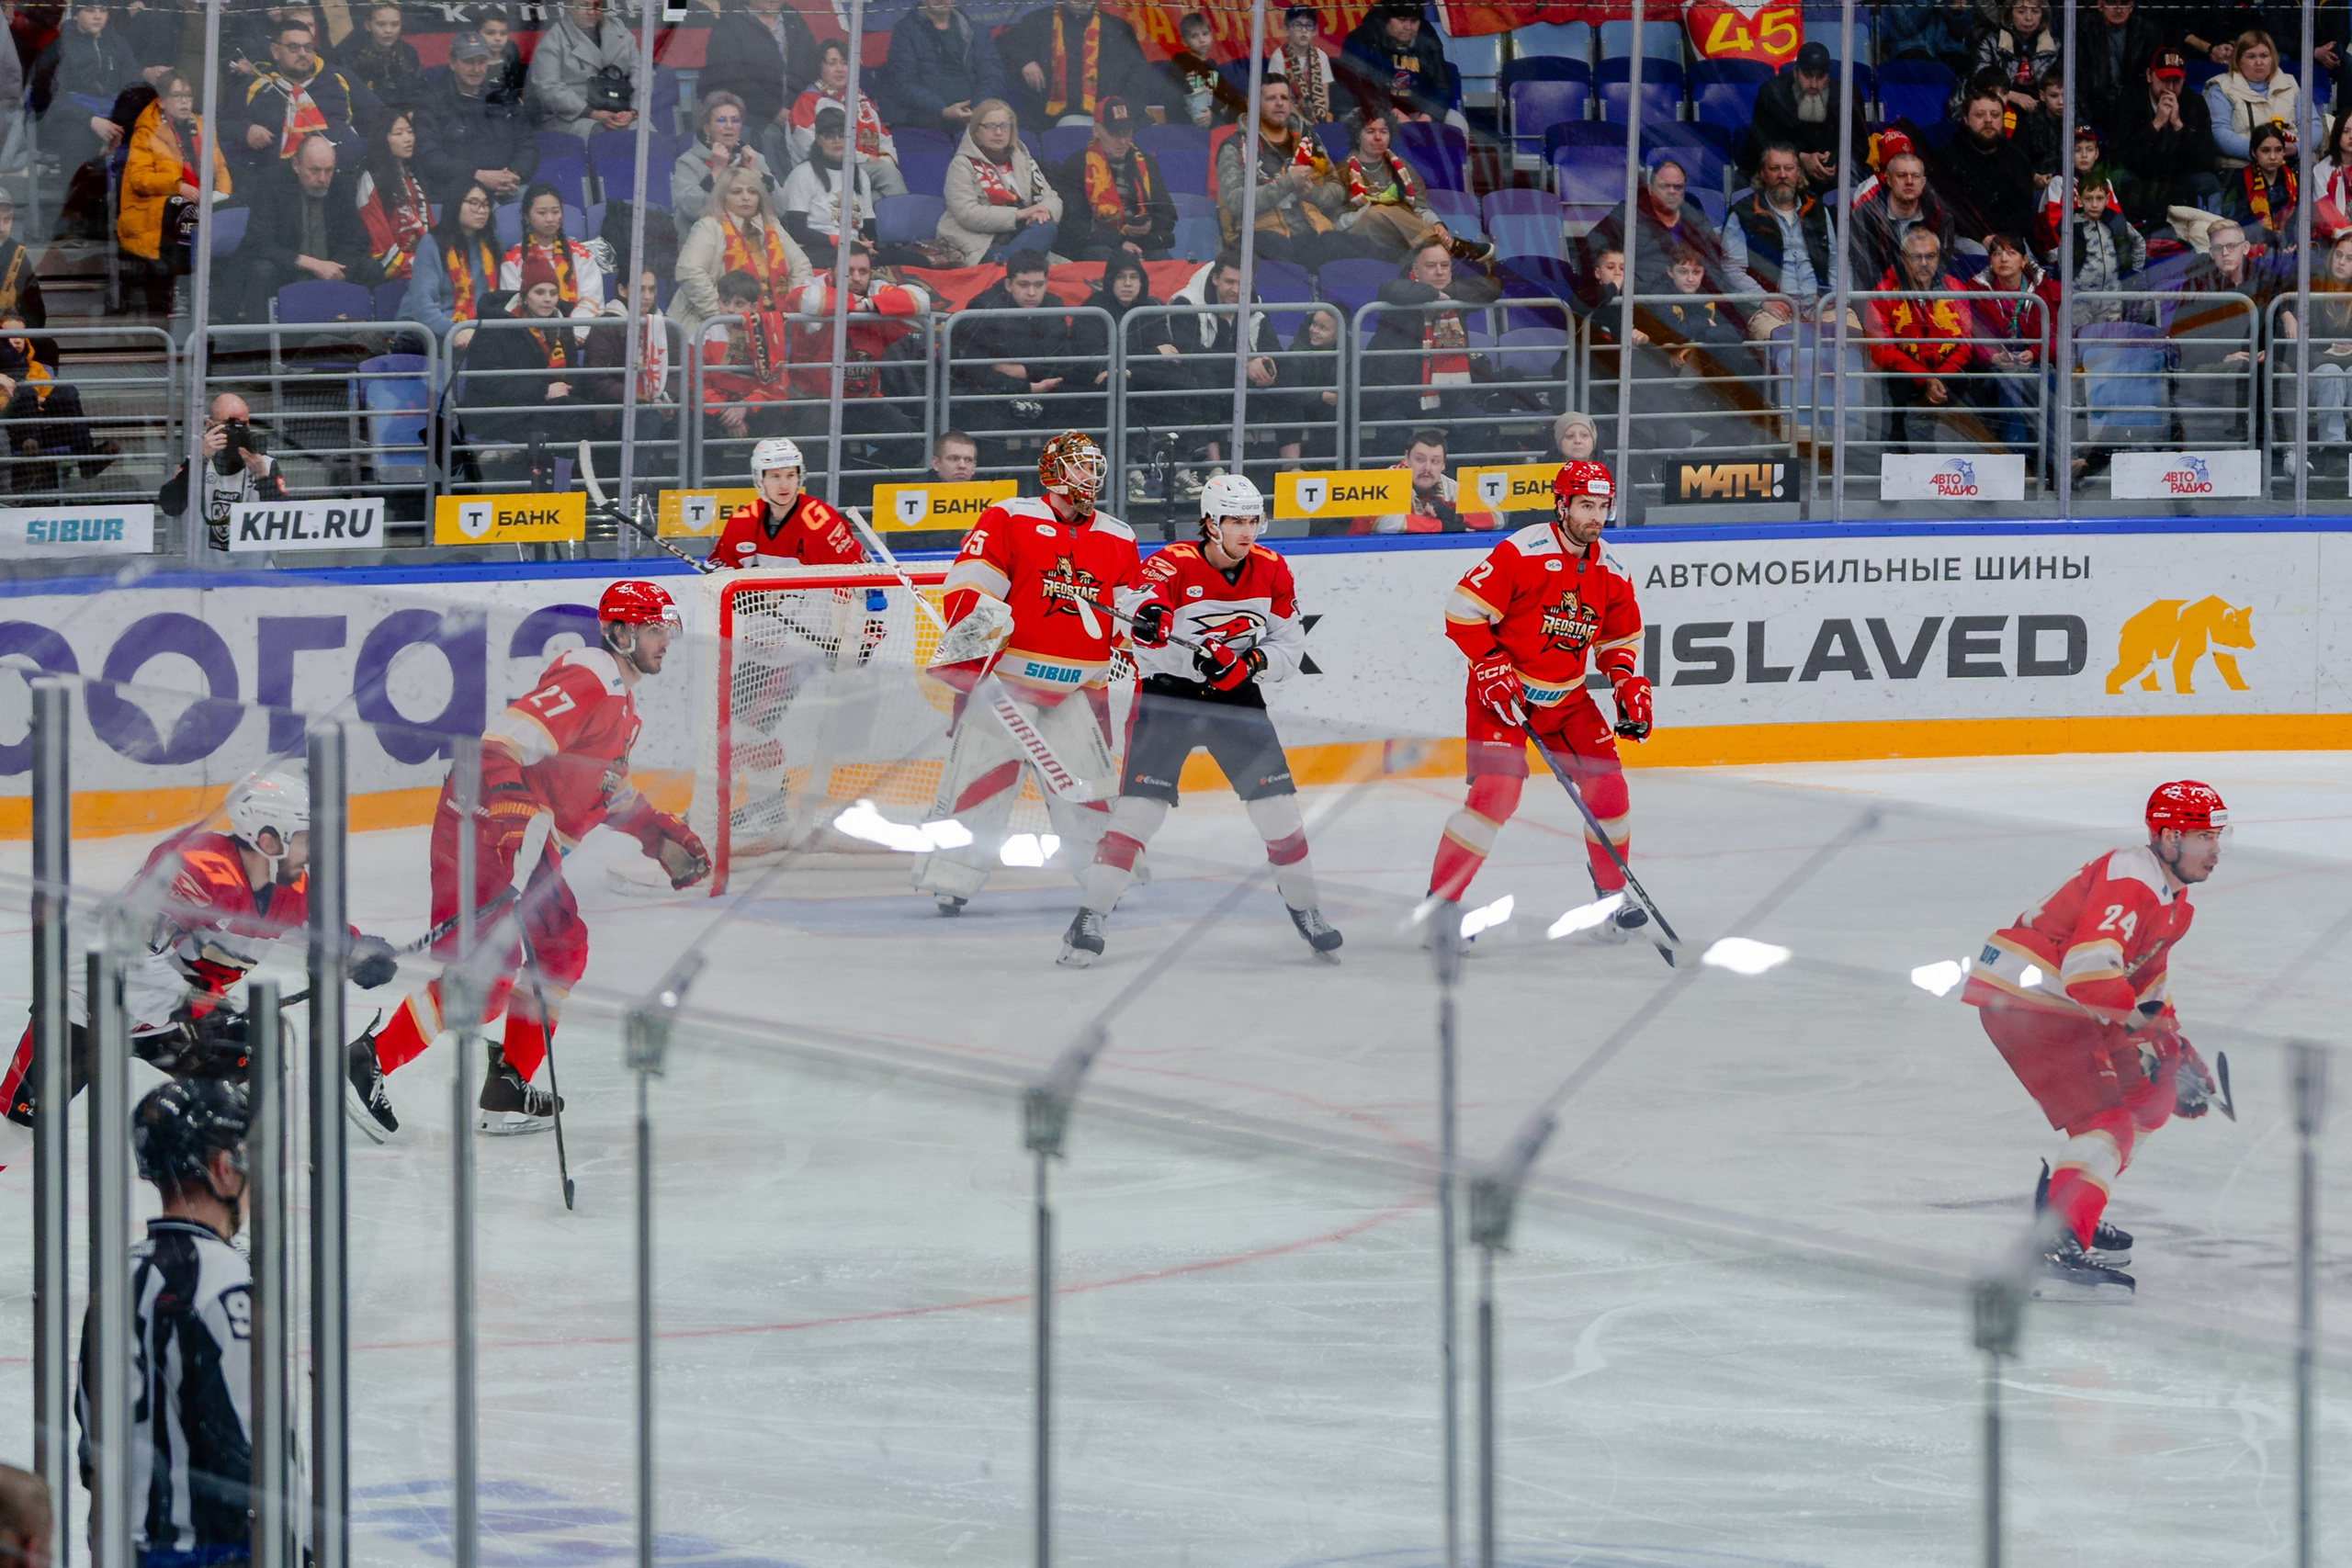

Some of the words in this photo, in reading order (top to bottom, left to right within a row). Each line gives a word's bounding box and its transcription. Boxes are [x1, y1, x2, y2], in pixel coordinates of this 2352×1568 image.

[1705, 7, 1798, 56] 45
[1487, 482, 1499, 496] Т
[1512, 479, 1555, 495] БАН
[1680, 463, 1784, 498] МАТЧ!
[1929, 473, 1962, 485] АВТО
[2161, 470, 2195, 483] АВТО
[2171, 481, 2212, 493] РАДИО
[1305, 488, 1318, 502] Т
[1331, 485, 1390, 502] БАНК
[1938, 484, 1978, 496] РАДИО
[691, 505, 705, 521] Т
[719, 504, 746, 520] БА
[905, 500, 919, 515] Т
[933, 498, 994, 514] БАНК
[239, 507, 375, 542] KHL.RU
[468, 512, 483, 527] Т
[497, 509, 560, 526] БАНК
[25, 516, 125, 545] SIBUR
[1465, 558, 1495, 590] 2
[1645, 557, 1962, 590] АВТОМОБИЛЬНЫЕ
[1974, 555, 2091, 581] ШИНЫ
[1042, 578, 1102, 603] REDSTAR
[1540, 614, 1599, 643] REDSTAR
[1584, 614, 2088, 689] ISLAVED
[1023, 661, 1083, 683] SIBUR
[1476, 661, 1513, 682] CCM
[529, 684, 577, 718] 27
[491, 801, 540, 817] WARRI
[2098, 904, 2139, 942] 24
